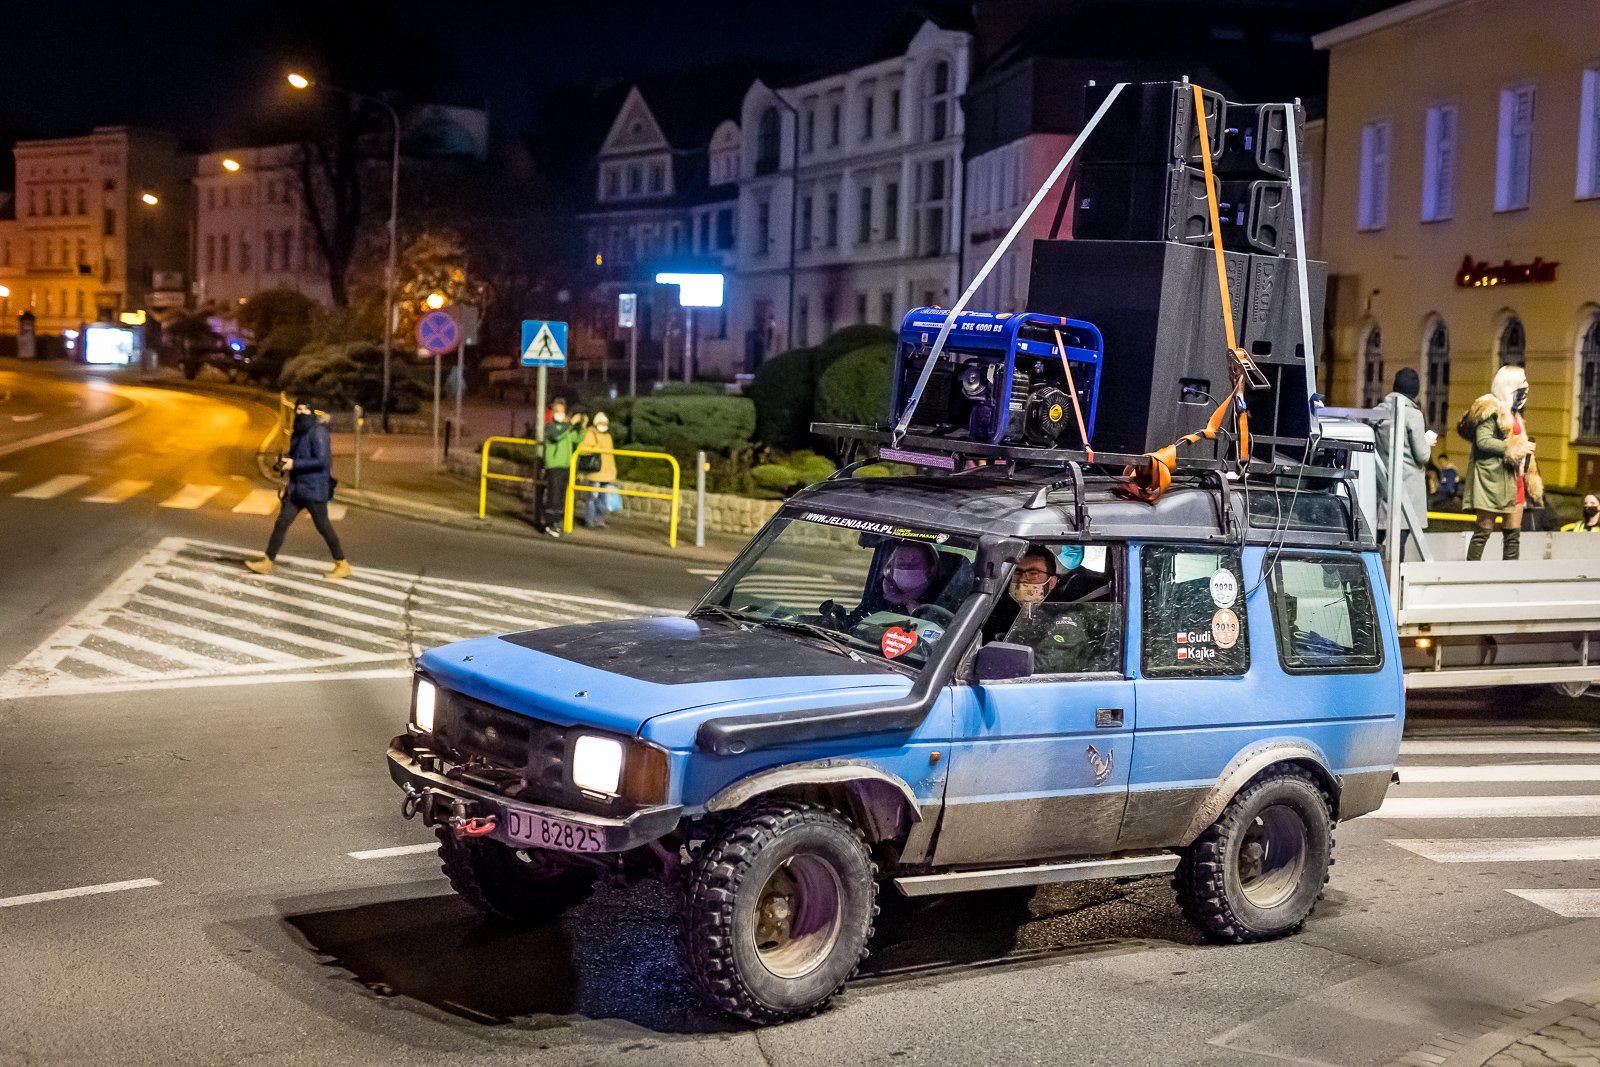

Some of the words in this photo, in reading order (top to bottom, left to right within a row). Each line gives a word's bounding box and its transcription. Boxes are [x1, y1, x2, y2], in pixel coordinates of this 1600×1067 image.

[961, 322, 975, 330] ESE
[976, 323, 992, 331] 4000
[805, 512, 893, 534] WWW.JELENIA4X4.PL
[1215, 623, 1236, 632] 2019
[1187, 630, 1211, 643] Gudi
[1187, 646, 1215, 661] Kajka
[541, 819, 602, 852] 82825
